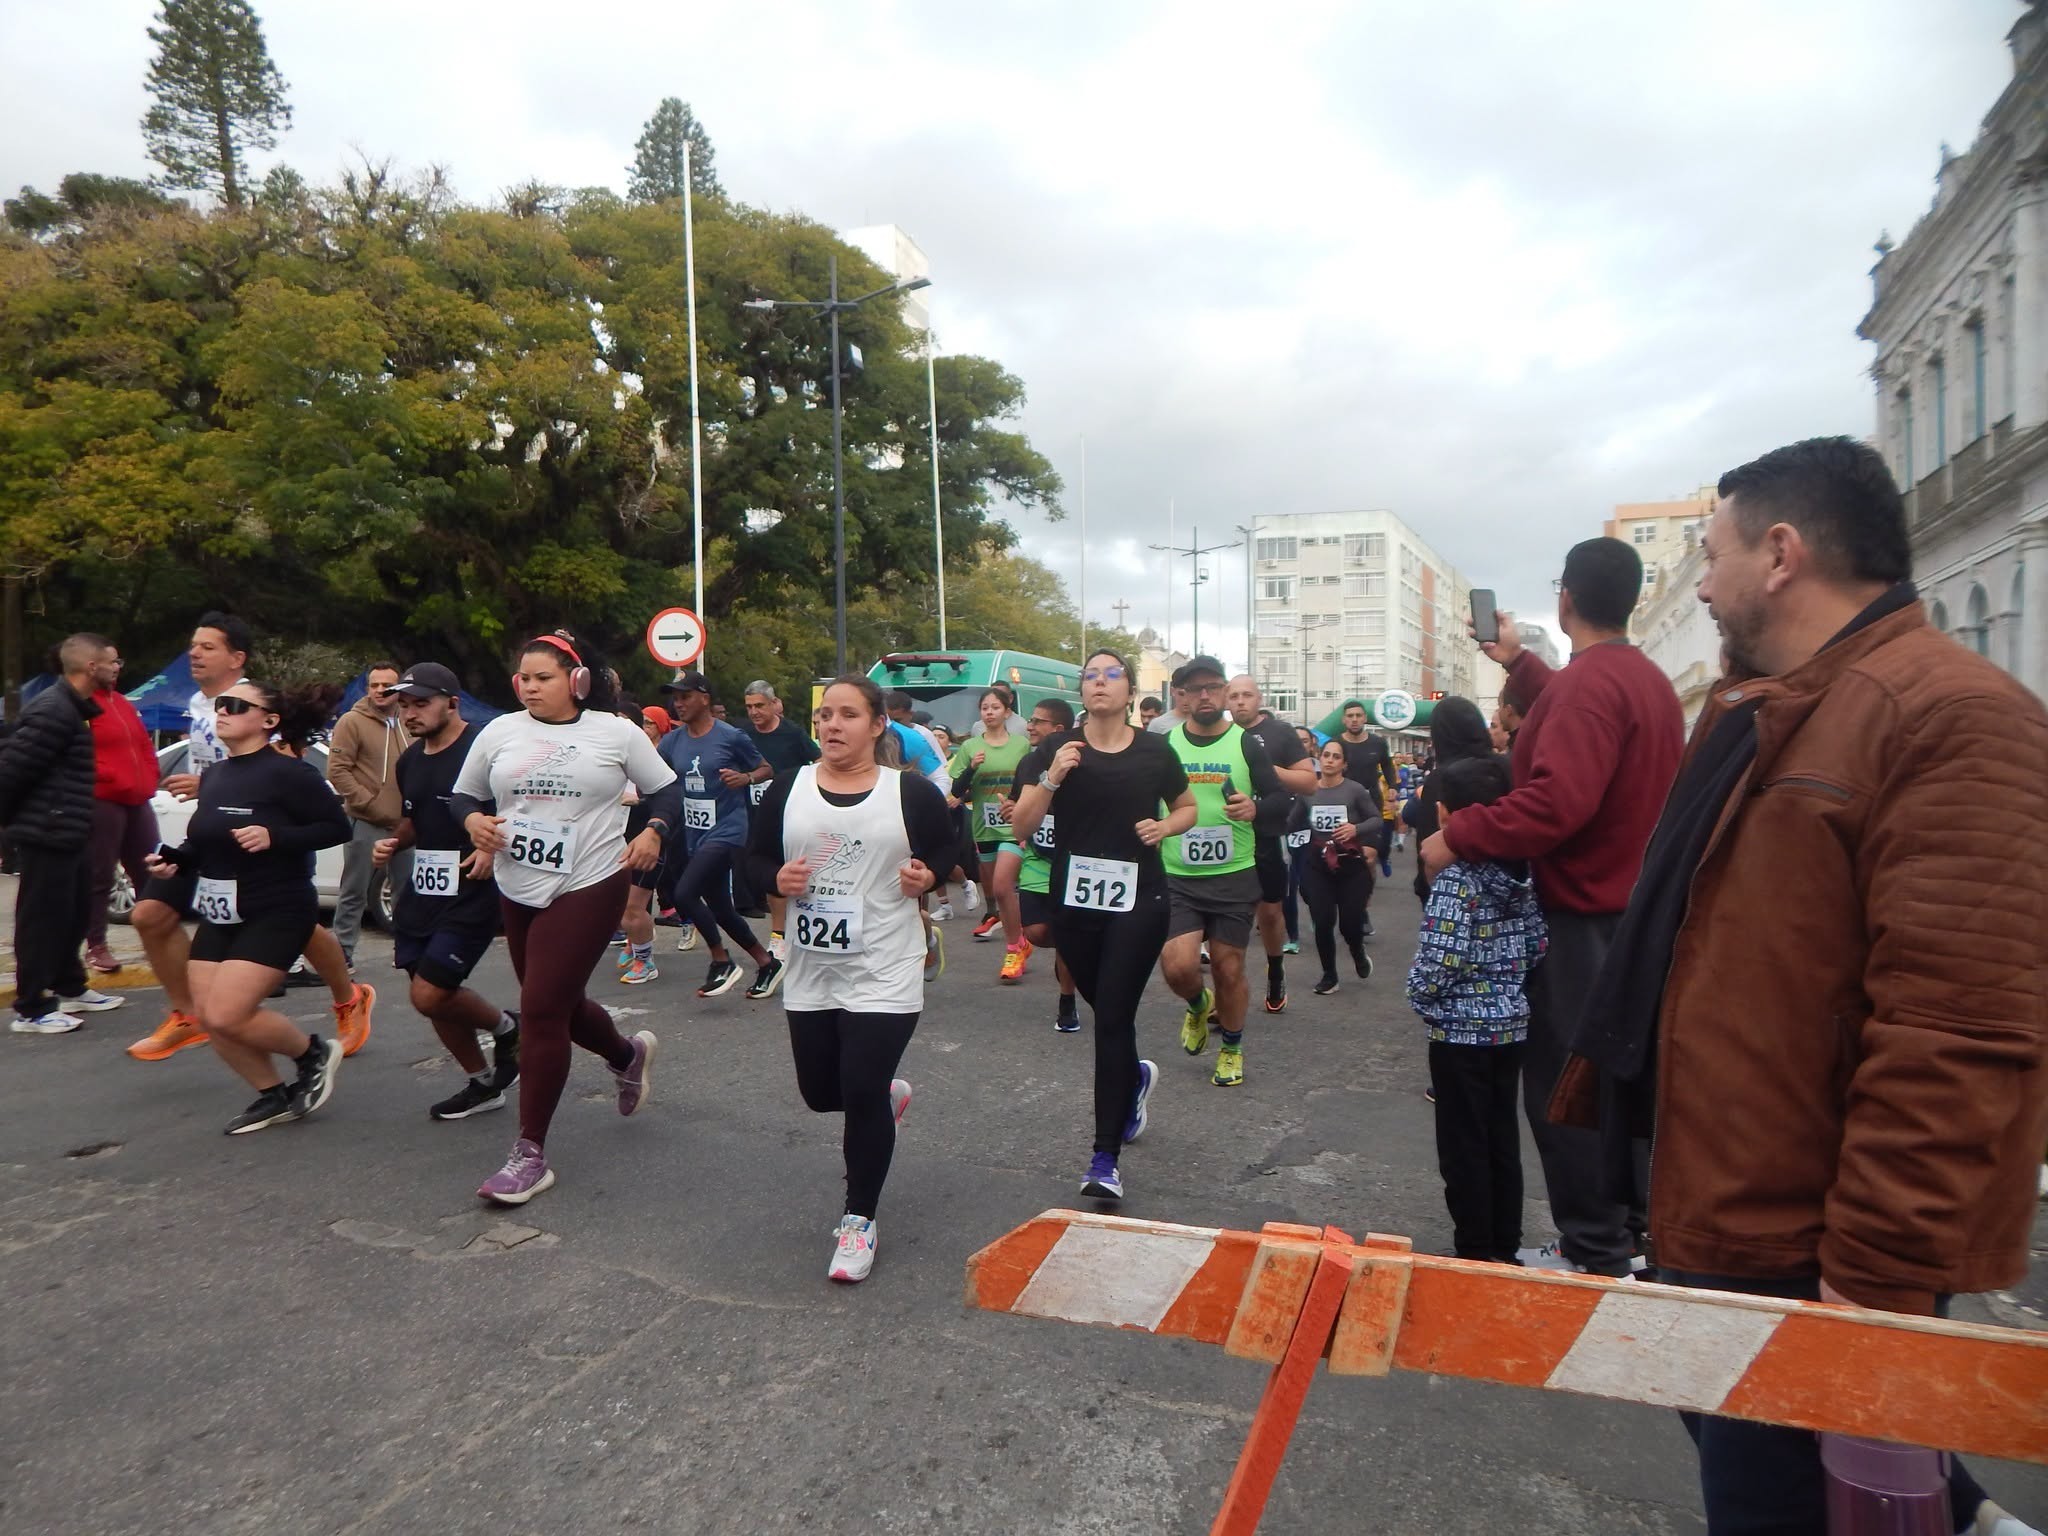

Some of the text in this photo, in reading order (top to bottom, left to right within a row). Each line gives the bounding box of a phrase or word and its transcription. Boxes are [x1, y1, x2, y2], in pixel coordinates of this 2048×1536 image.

[687, 809, 710, 827] 652
[1316, 816, 1341, 829] 825
[510, 834, 565, 869] 584
[1188, 840, 1227, 862] 620
[416, 866, 450, 891] 665
[1074, 876, 1127, 908] 512
[198, 895, 232, 920] 633
[797, 914, 851, 949] 824
